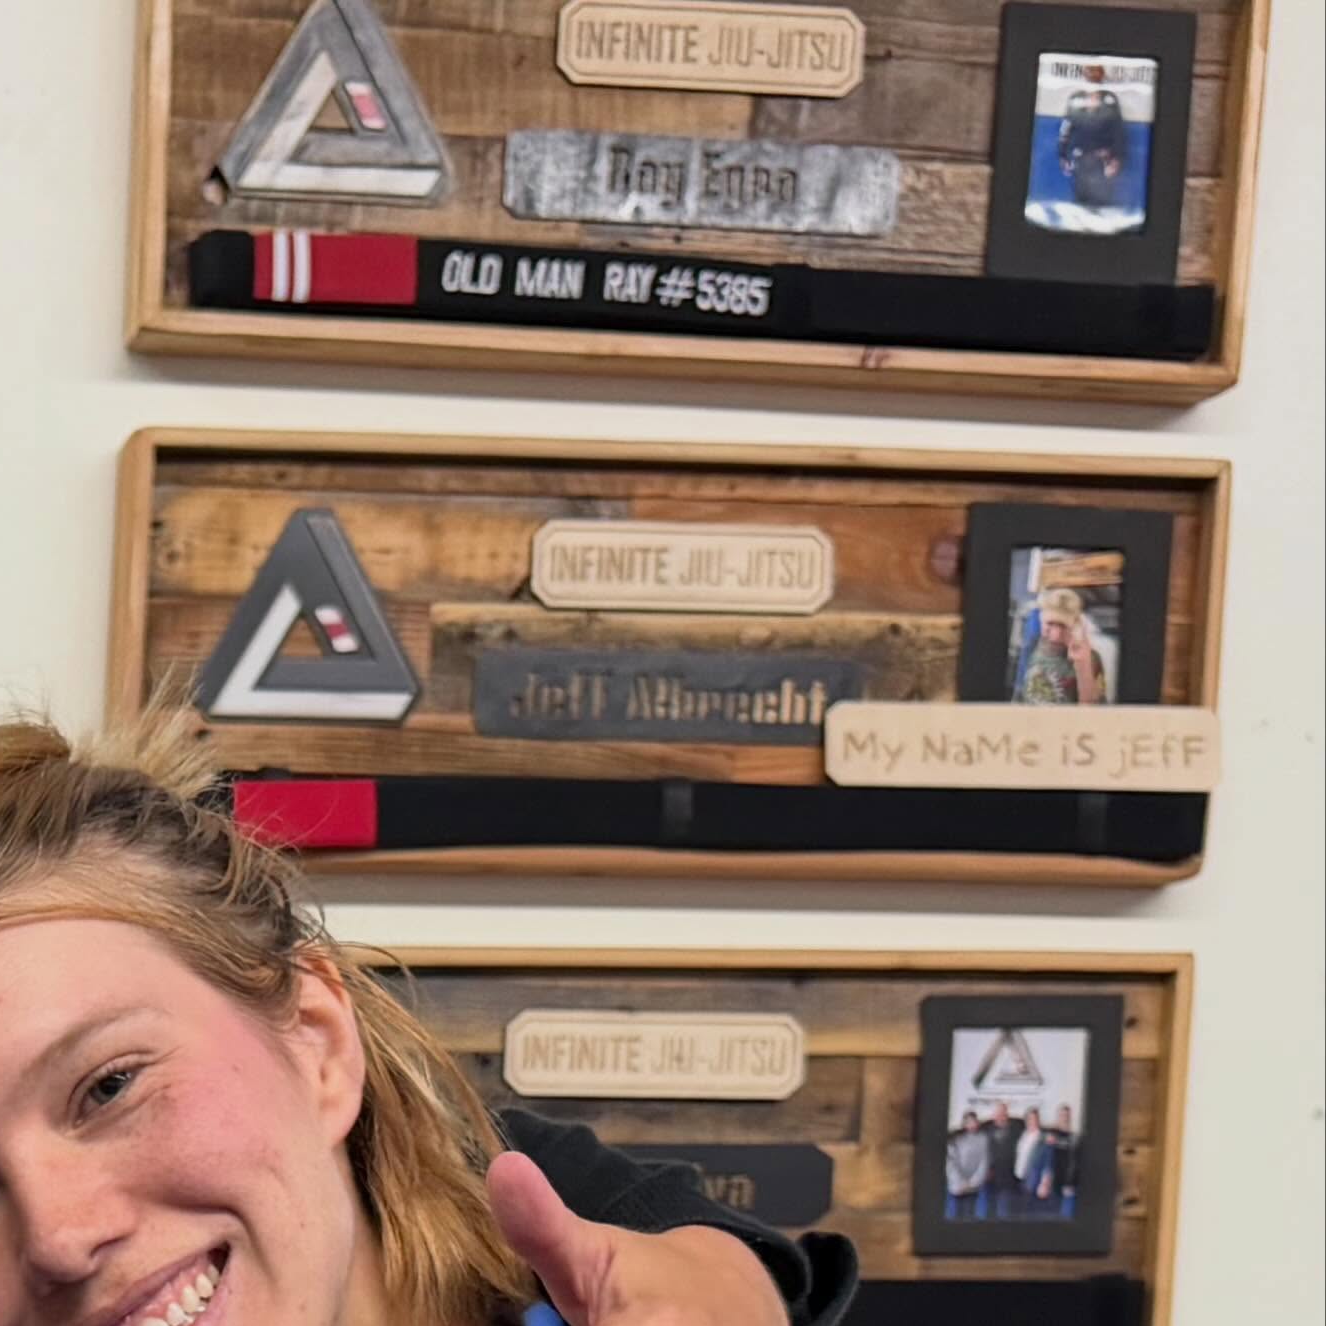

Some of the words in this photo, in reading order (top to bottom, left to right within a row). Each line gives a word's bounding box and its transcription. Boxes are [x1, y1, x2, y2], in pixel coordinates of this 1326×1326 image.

[576, 19, 698, 64] INFINITE
[708, 25, 847, 72] JIU-JITSU
[441, 250, 503, 296] OLD
[514, 256, 587, 300] MAN
[549, 544, 669, 585] INFINITE
[679, 549, 816, 590] JIU-JITSU
[841, 730, 905, 773] My
[521, 1033, 642, 1073] INFINITE
[650, 1037, 788, 1077] JIU-JITSU
